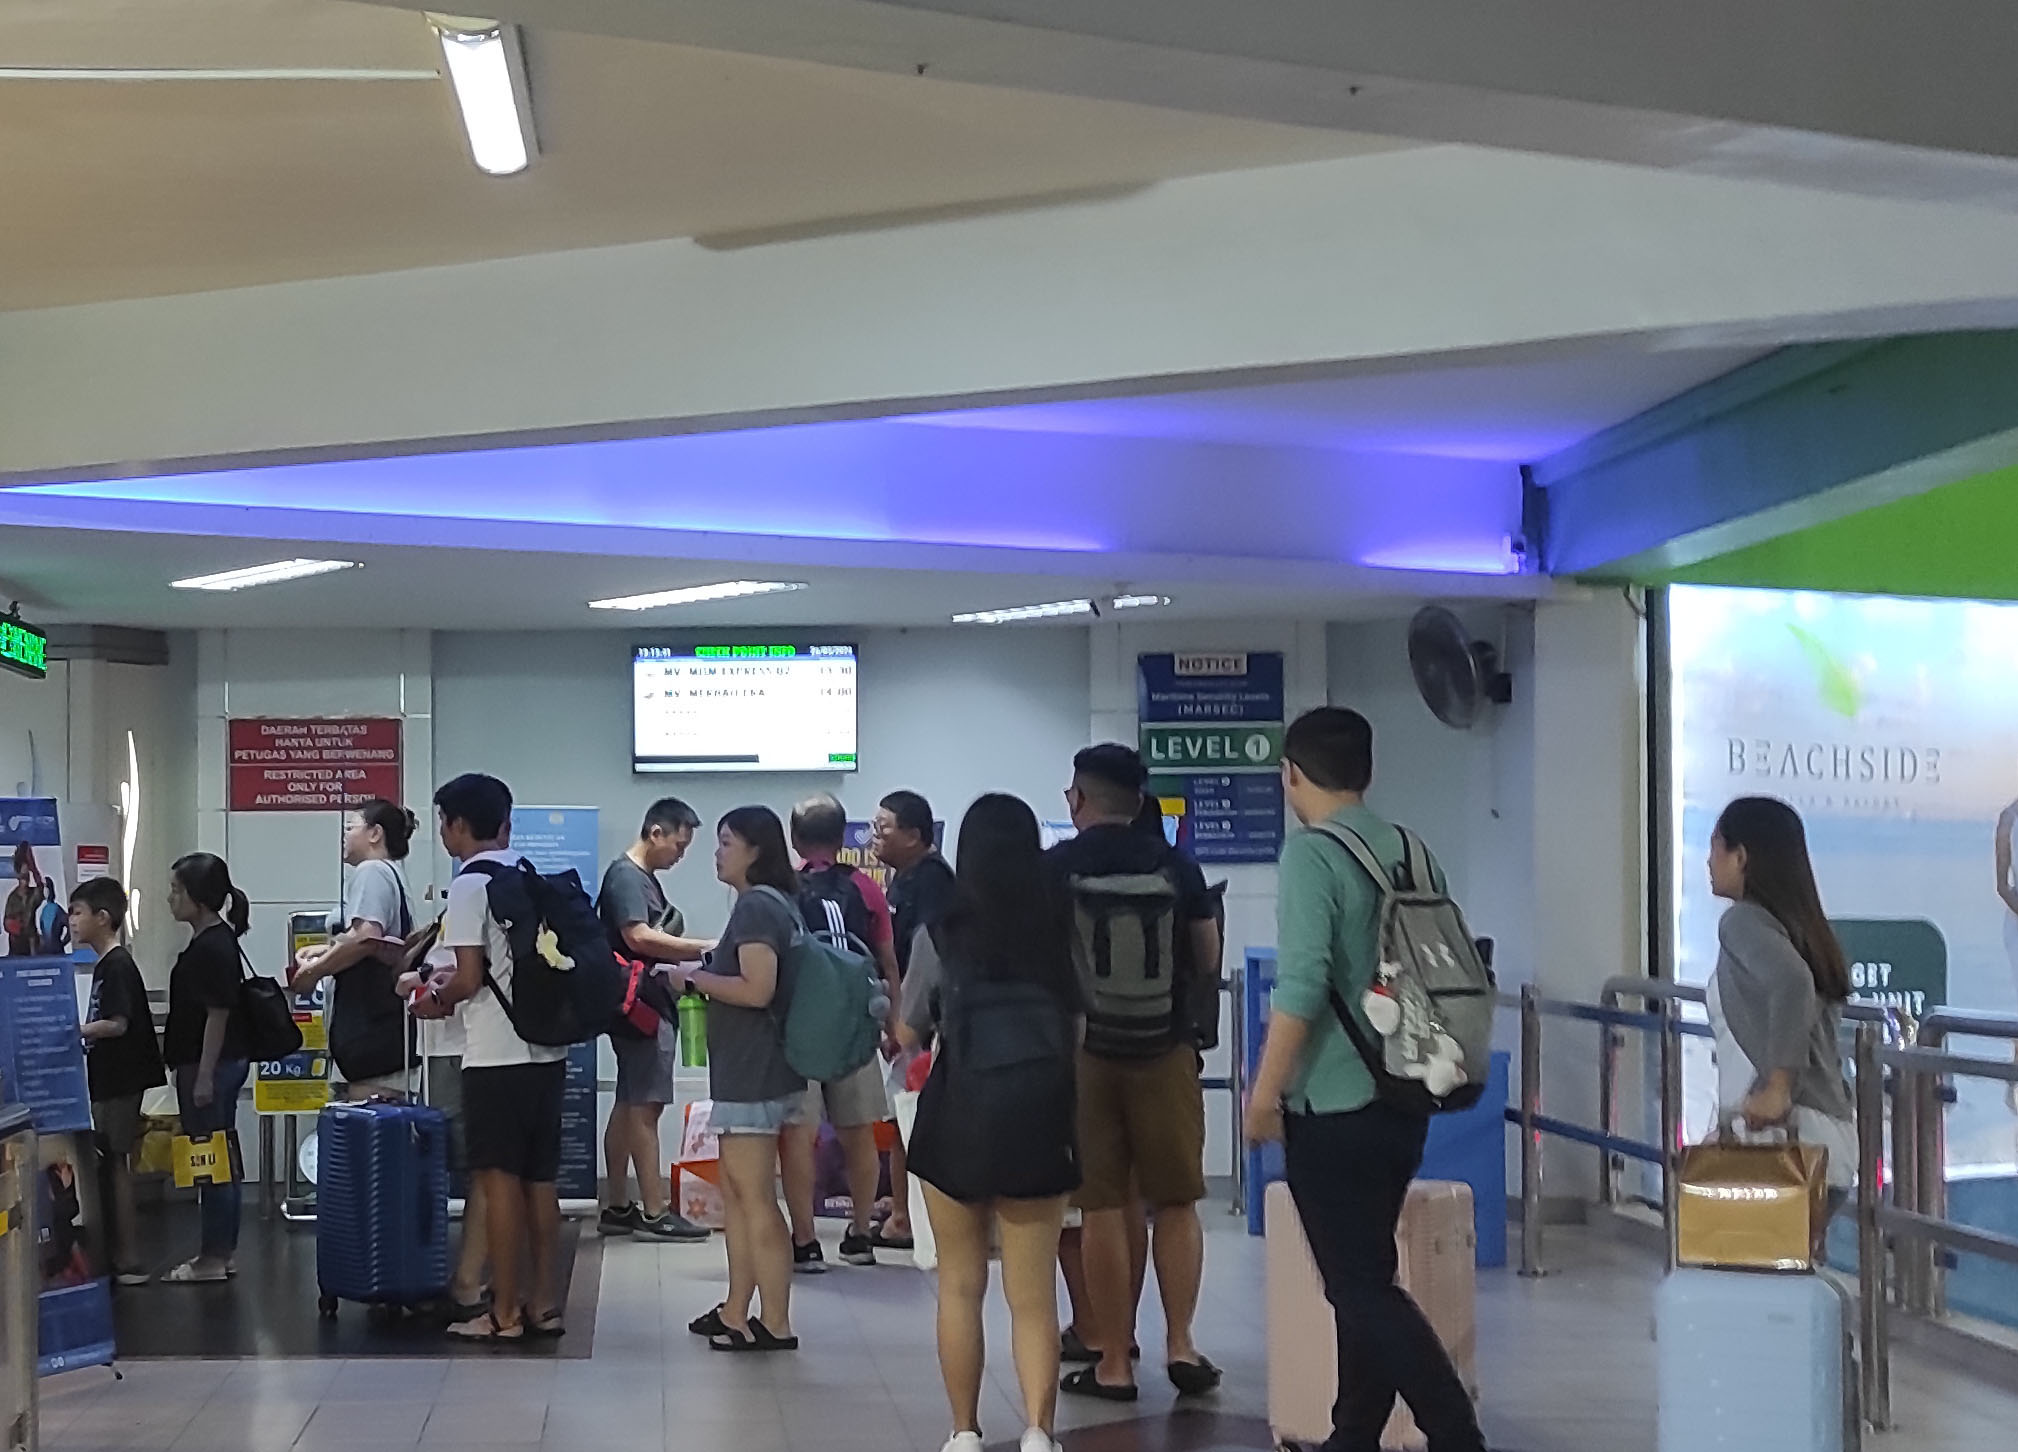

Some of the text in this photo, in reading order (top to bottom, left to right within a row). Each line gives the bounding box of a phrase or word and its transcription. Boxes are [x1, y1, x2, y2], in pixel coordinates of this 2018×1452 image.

[731, 645, 767, 657] POINT
[1179, 658, 1241, 671] NOTICE
[1178, 703, 1244, 716] (MARSEC)
[261, 724, 368, 736] DAERAH TERBATAS
[275, 737, 353, 748] HANYA UNTUK
[1151, 735, 1239, 760] LEVEL
[234, 749, 395, 760] PETUGAS YANG BERWENANG
[1728, 737, 1941, 784] BEACHSIDE
[264, 769, 367, 780] RESTRICTED AREA
[287, 782, 343, 792] ONLY FOR
[255, 794, 327, 805] AUTHORISED
[260, 1061, 302, 1077] 20 Kg
